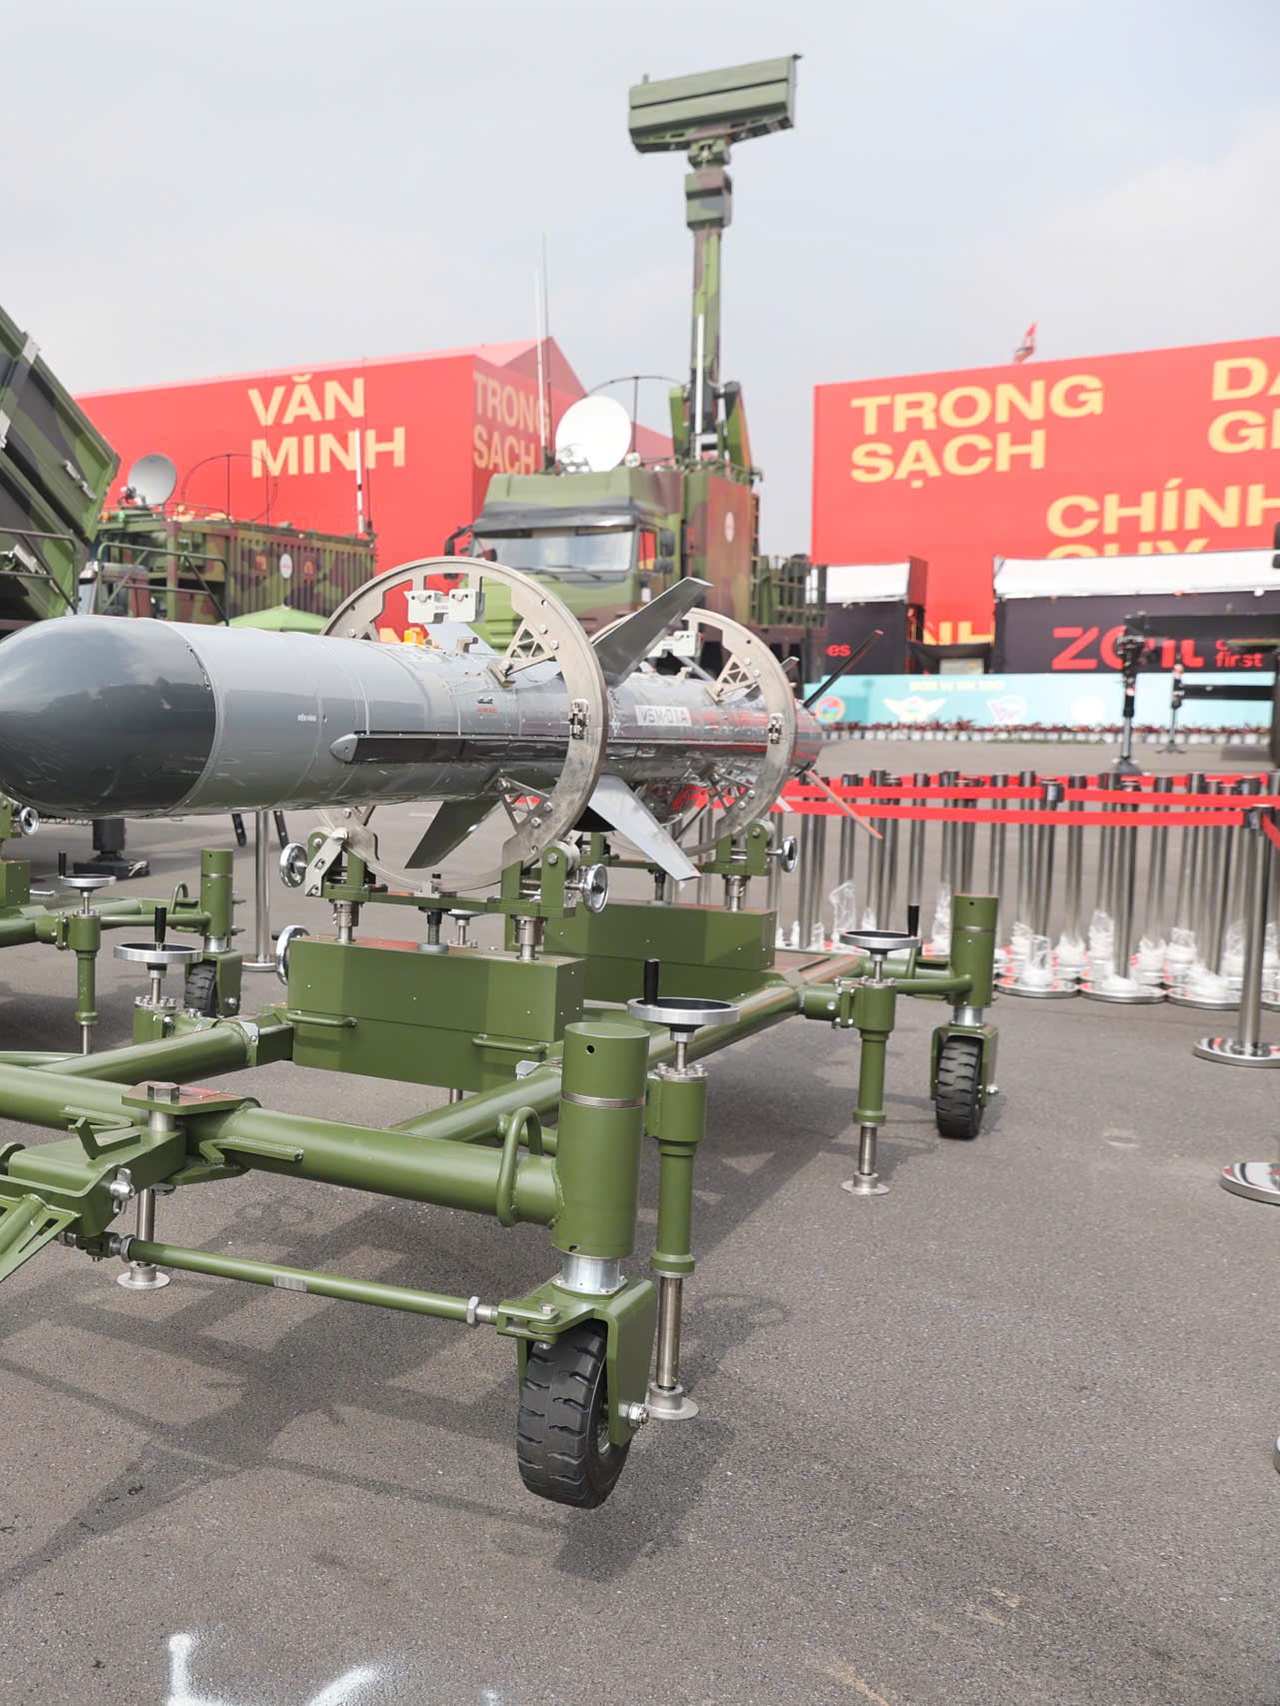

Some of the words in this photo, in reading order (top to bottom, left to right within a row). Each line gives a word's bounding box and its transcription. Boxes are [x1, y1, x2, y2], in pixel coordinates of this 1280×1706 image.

[247, 374, 365, 427] VĂN
[850, 374, 1104, 435] TRONG
[251, 426, 406, 478] MINH
[850, 429, 1046, 488] SẠCH
